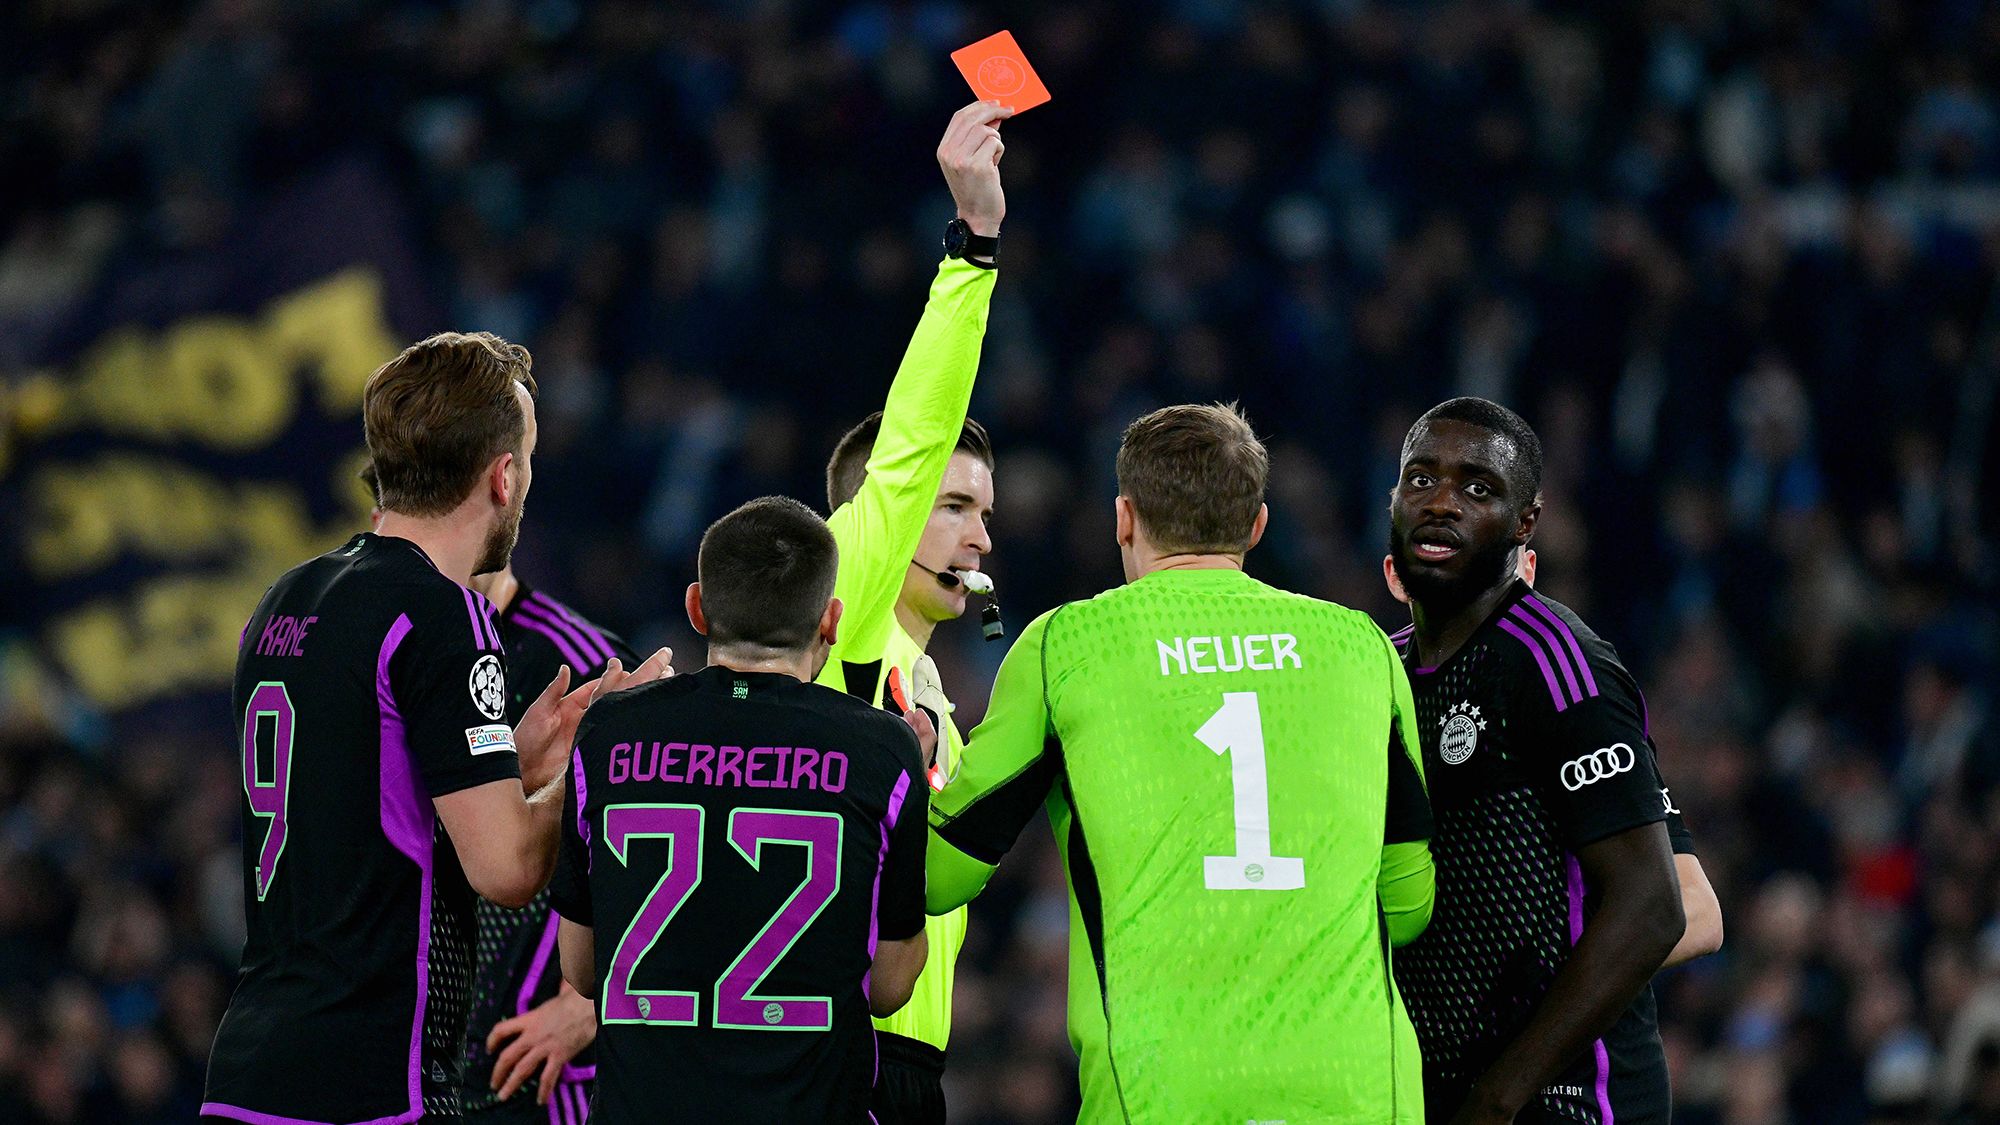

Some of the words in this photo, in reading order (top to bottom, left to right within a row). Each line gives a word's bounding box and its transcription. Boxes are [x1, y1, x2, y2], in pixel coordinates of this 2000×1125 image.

[256, 615, 318, 656] KANE
[1156, 633, 1303, 676] NEUER
[468, 728, 484, 736] UEFA
[243, 681, 295, 901] 9
[608, 741, 849, 794] GUERREIRO
[1193, 691, 1305, 890] 1
[602, 803, 844, 1032] 22
